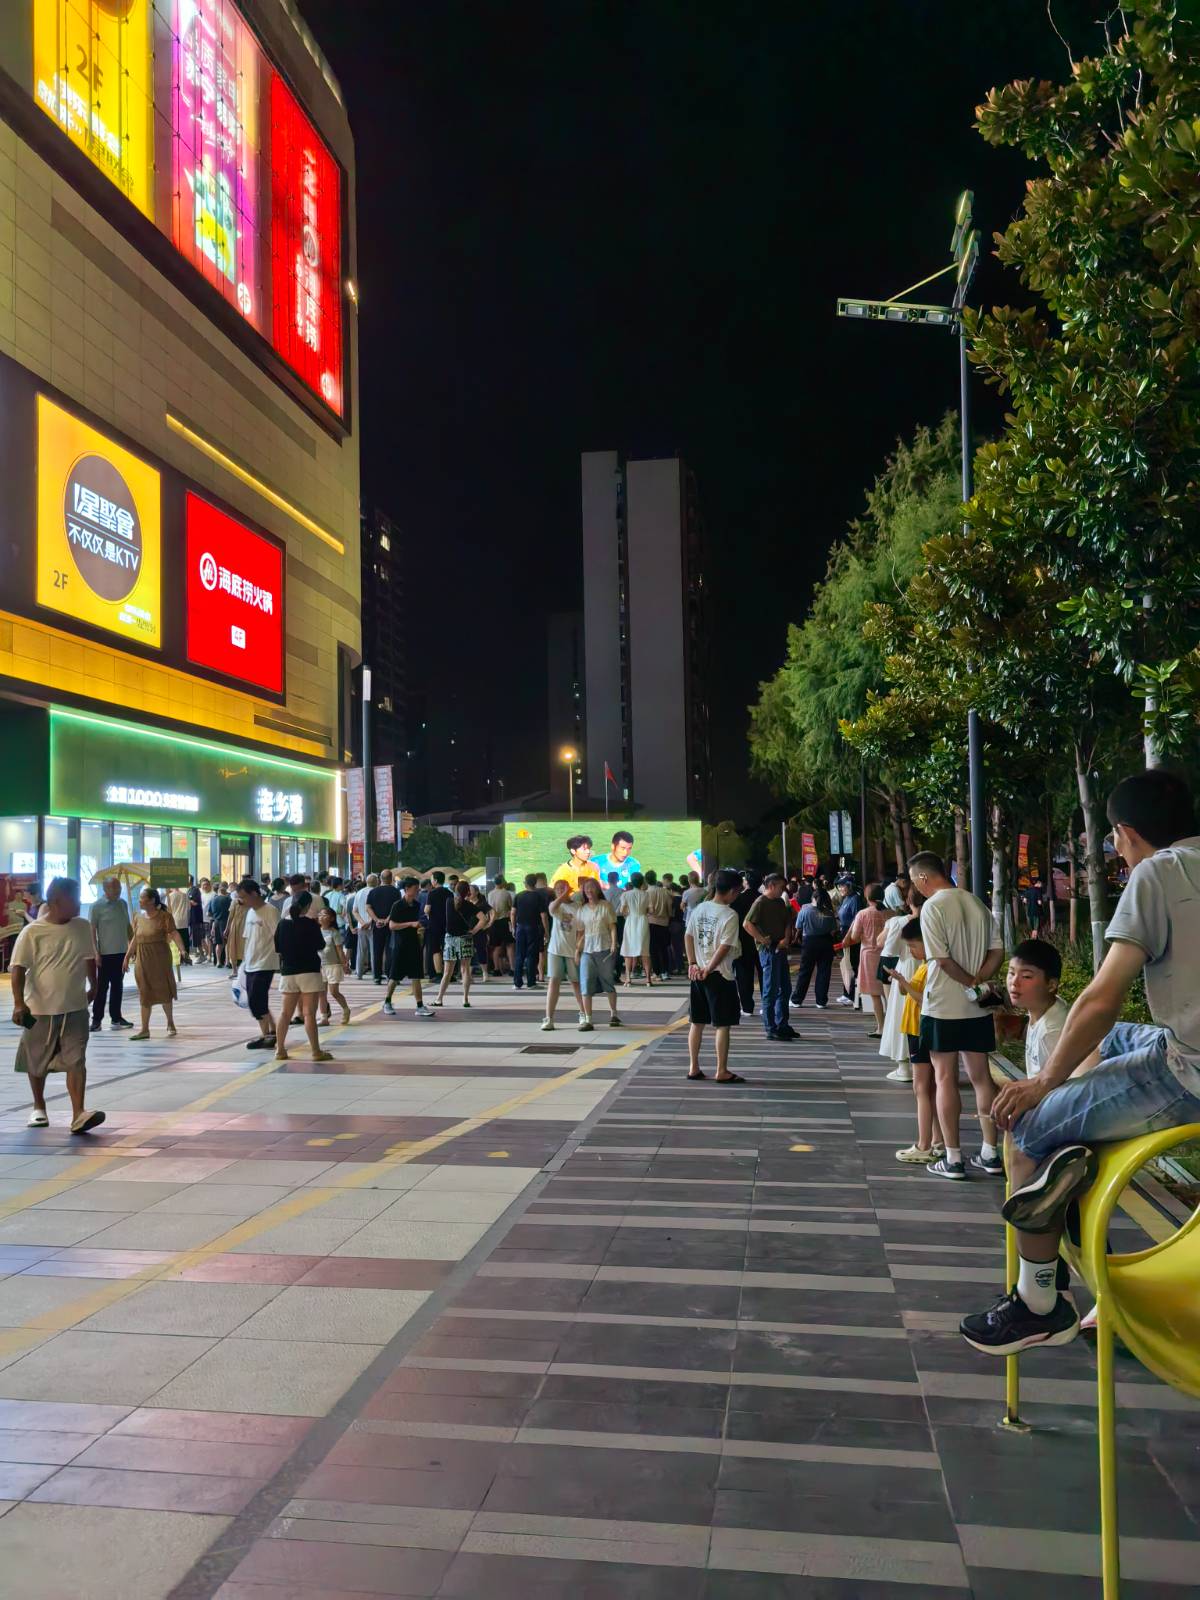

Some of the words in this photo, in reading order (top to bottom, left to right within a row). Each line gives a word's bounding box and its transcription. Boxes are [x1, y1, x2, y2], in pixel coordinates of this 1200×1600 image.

[76, 43, 104, 93] 2F
[68, 522, 139, 571] 不仅仅是KTV
[53, 570, 69, 590] 2F
[218, 566, 273, 615] 海底捞火锅
